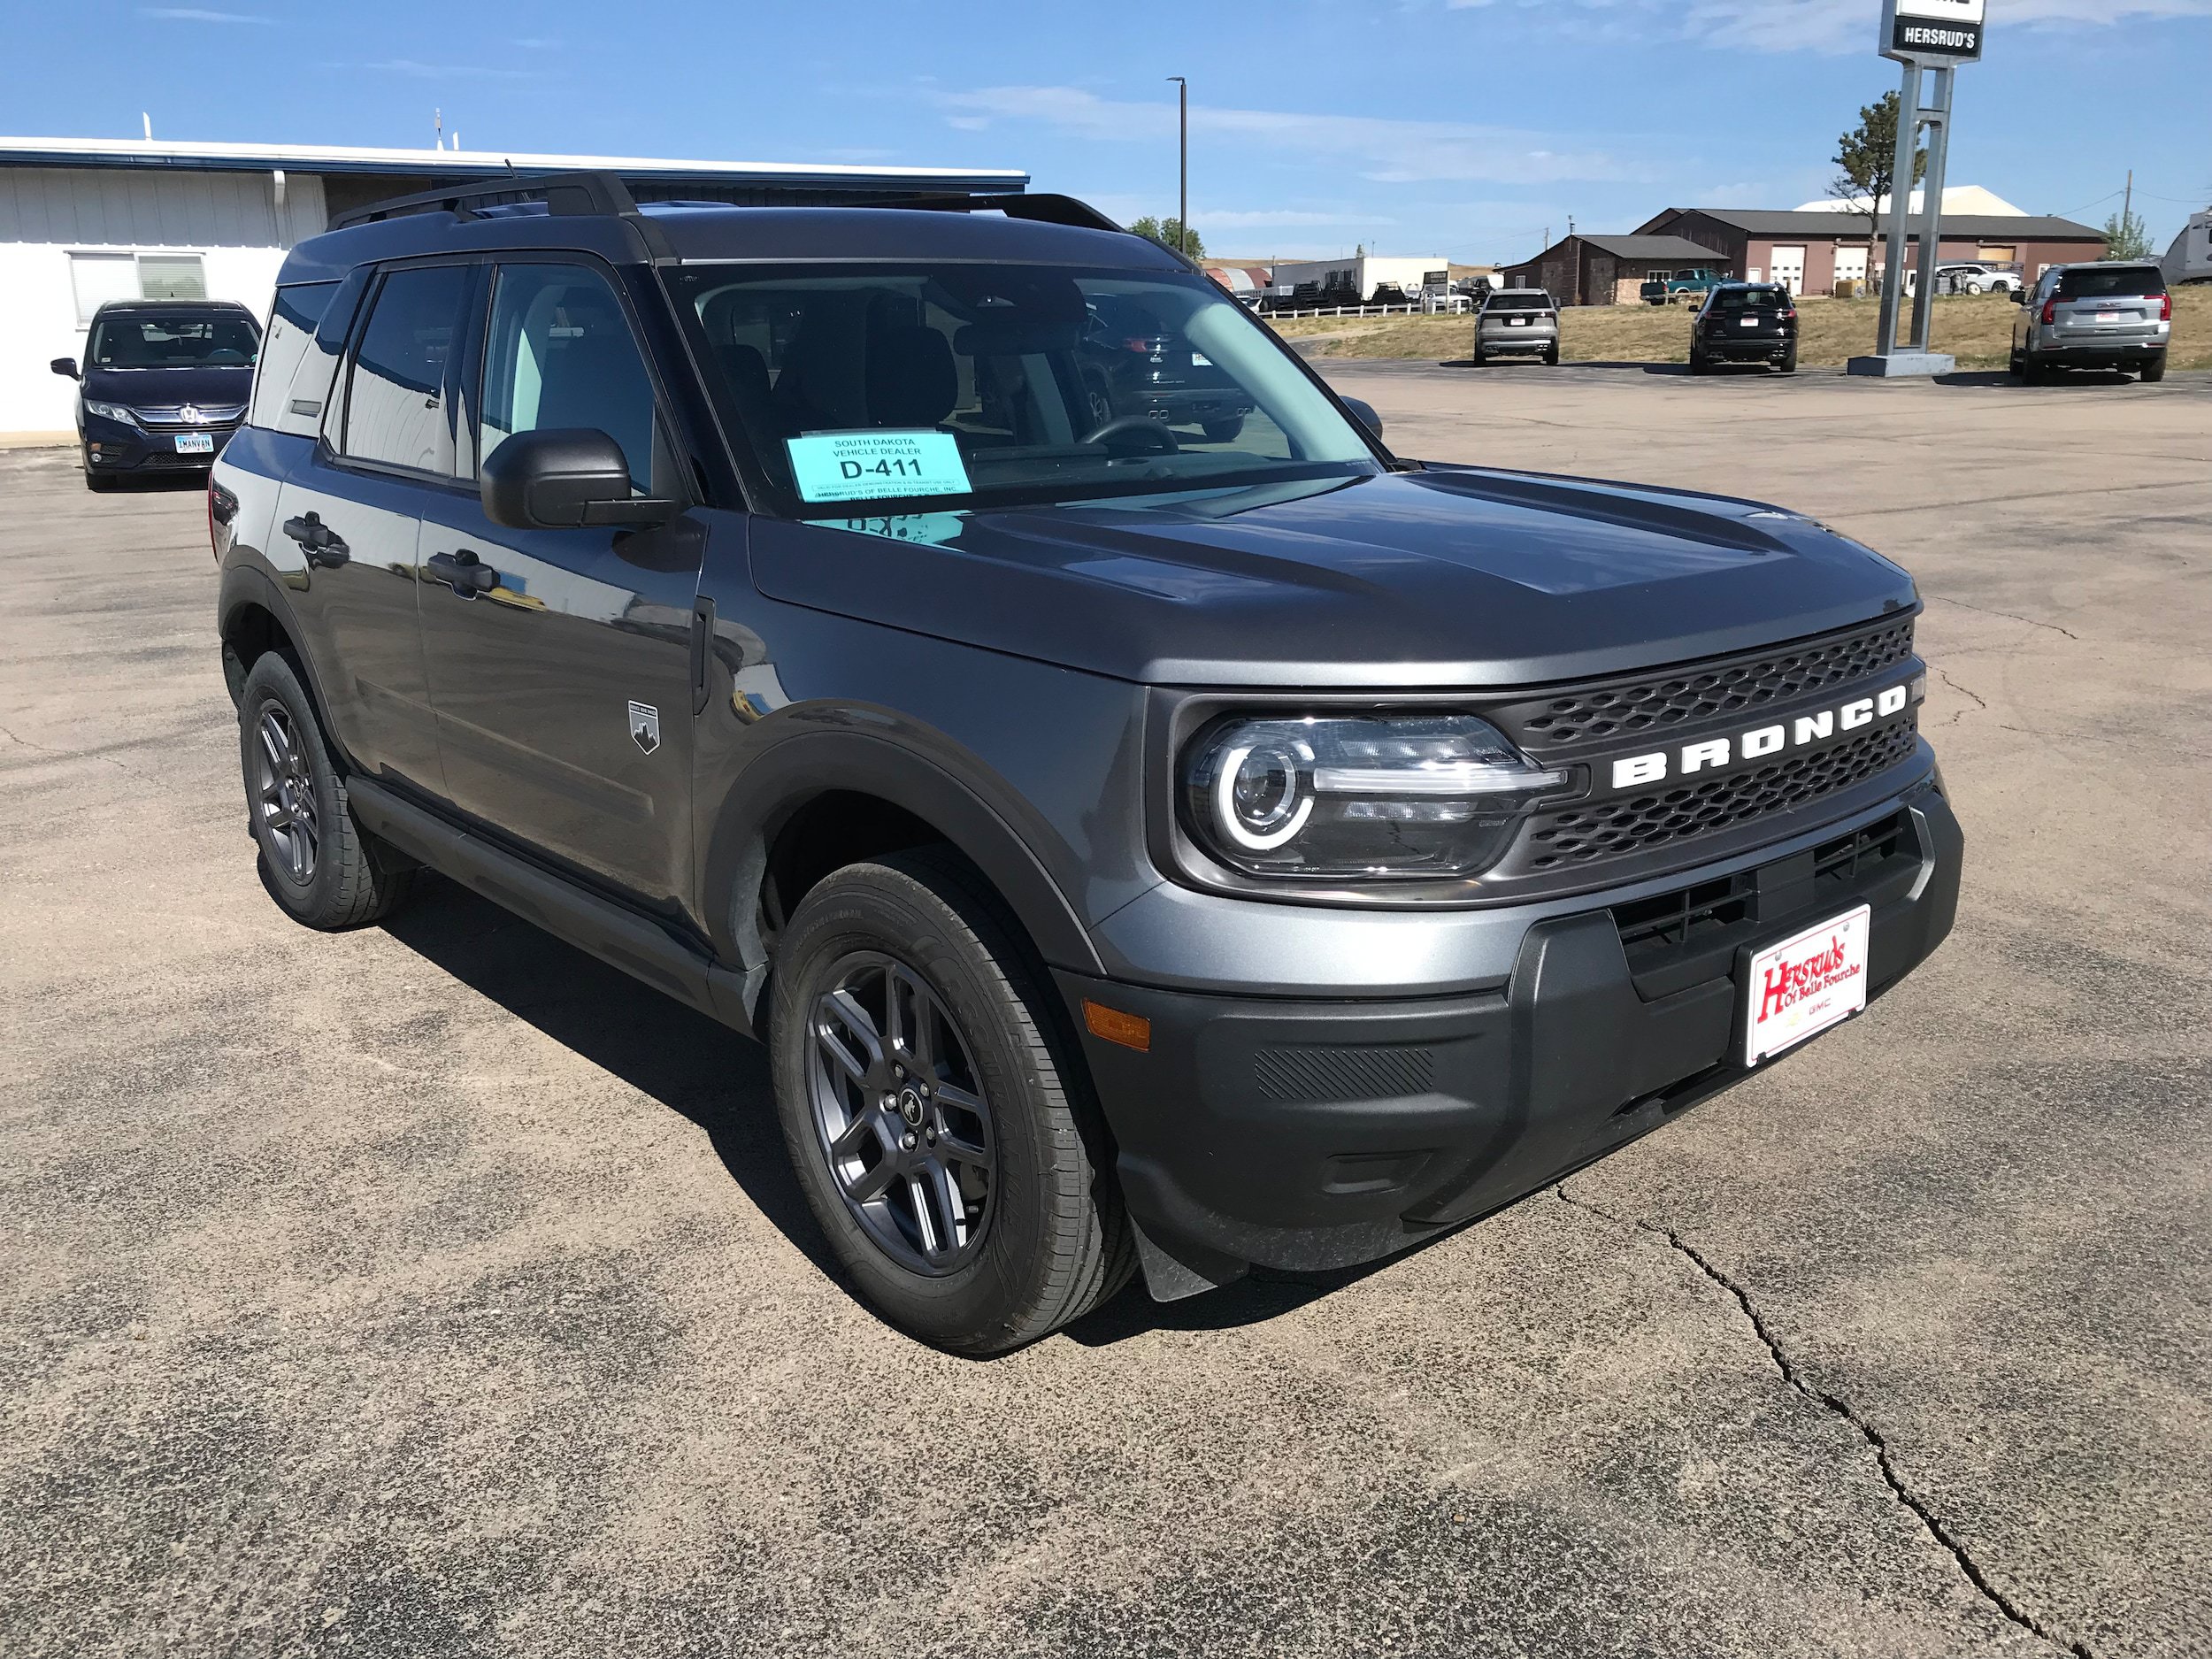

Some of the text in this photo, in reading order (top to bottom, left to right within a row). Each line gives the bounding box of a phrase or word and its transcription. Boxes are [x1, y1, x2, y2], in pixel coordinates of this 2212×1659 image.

[1904, 27, 1975, 49] HERSRUD'S
[833, 448, 878, 457] VEHICLE
[834, 439, 871, 448] SOUTH
[840, 458, 922, 479] D-411
[1611, 685, 1907, 789] BRONCO
[1785, 963, 1861, 1008] Of Belle Fourche
[1809, 997, 1832, 1016] GMC
